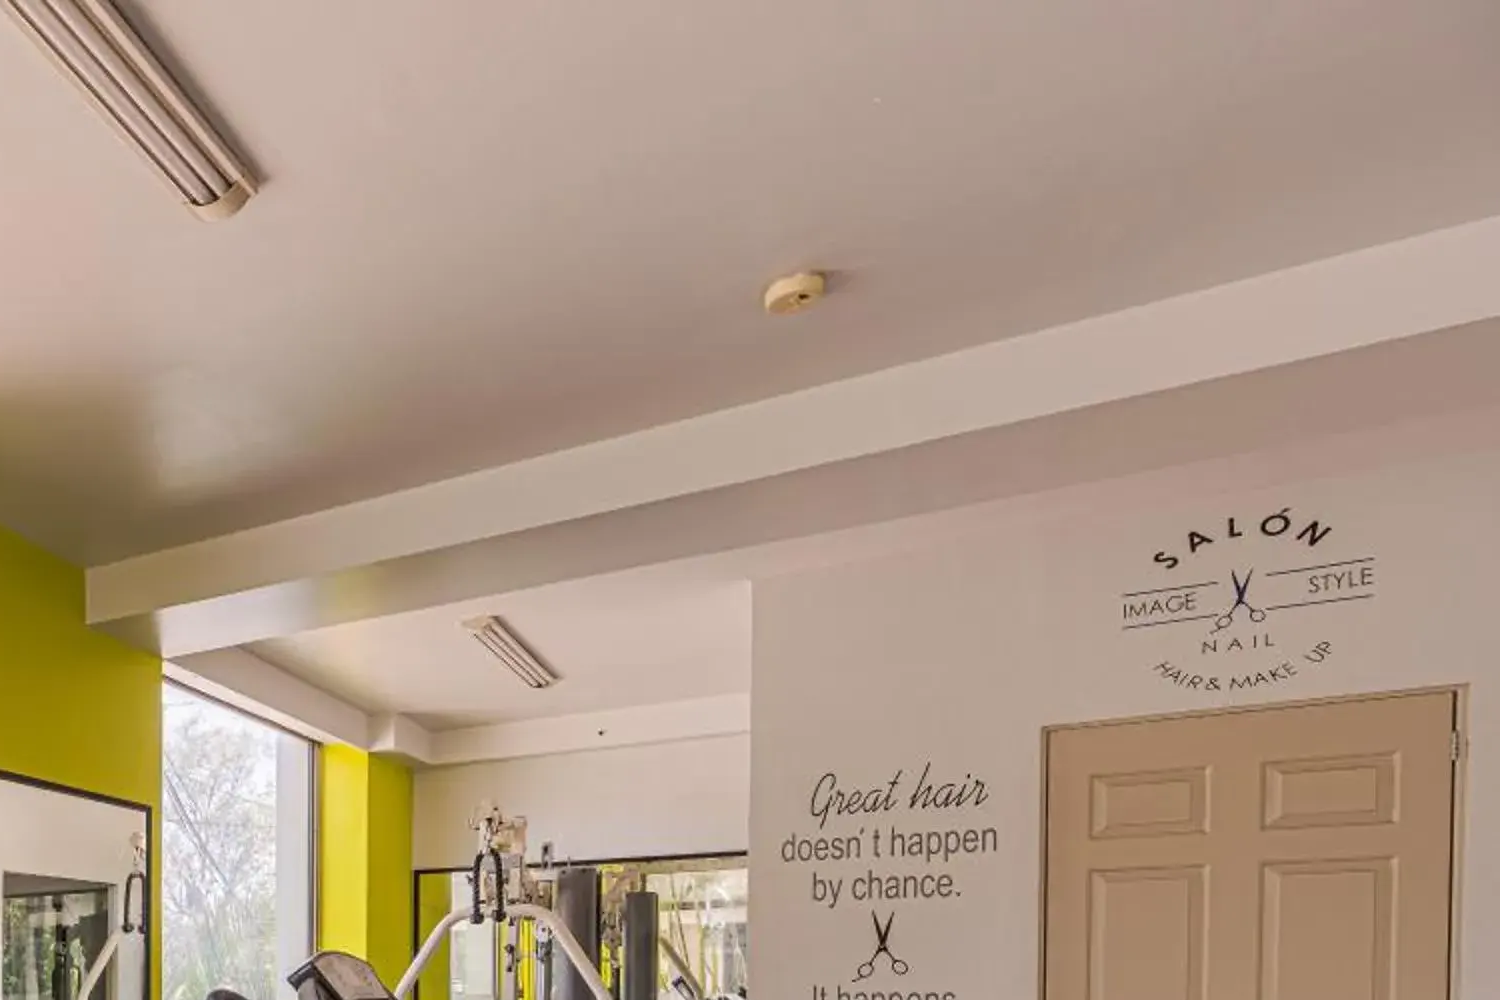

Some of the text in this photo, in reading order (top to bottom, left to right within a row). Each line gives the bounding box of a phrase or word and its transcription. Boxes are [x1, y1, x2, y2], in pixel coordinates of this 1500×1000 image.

[1153, 507, 1333, 570] SALÓN
[1122, 566, 1375, 620] IMAGE STYLE
[1202, 633, 1276, 655] NAIL
[1229, 661, 1299, 692] MAKE
[1303, 640, 1333, 664] UP
[810, 761, 990, 830] Great hair
[889, 825, 999, 864] happen
[812, 869, 962, 909] by chance.
